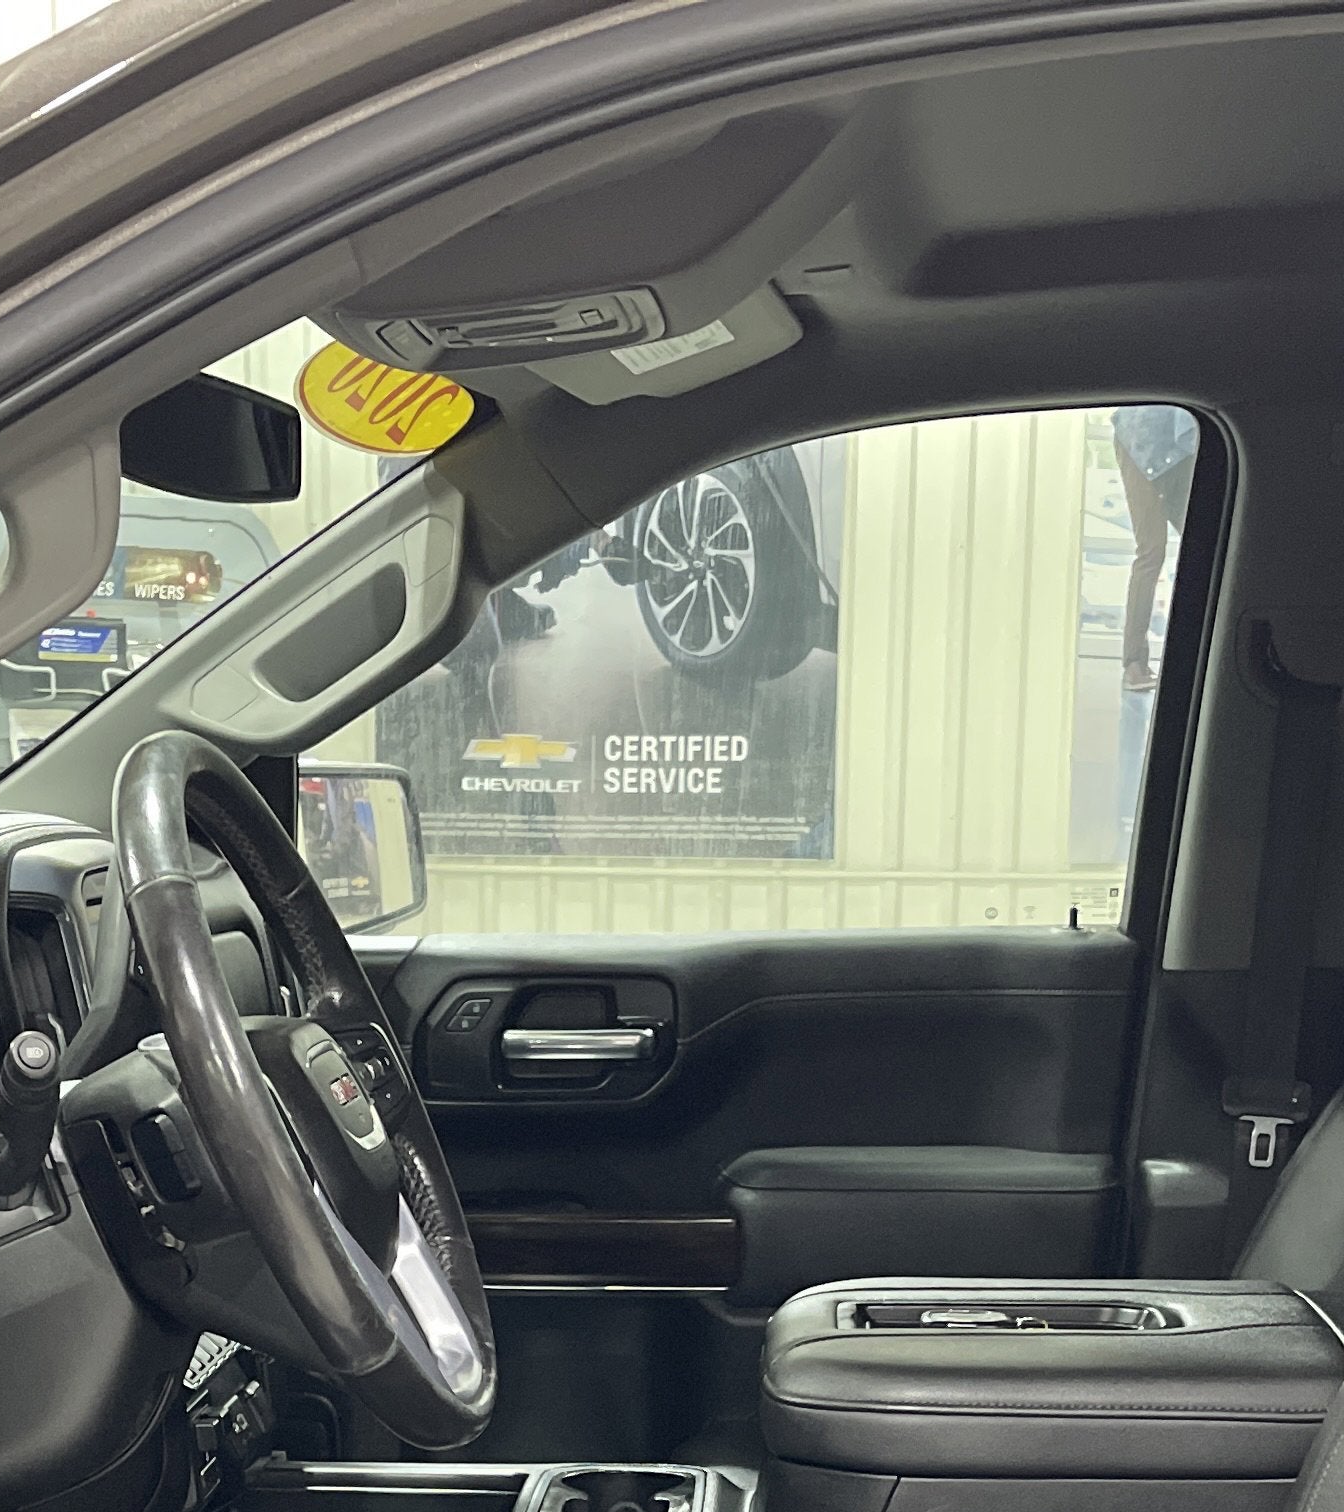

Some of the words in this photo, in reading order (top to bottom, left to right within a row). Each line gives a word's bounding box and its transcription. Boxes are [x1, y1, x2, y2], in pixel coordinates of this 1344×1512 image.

[93, 581, 115, 597] ES
[135, 583, 186, 600] WIPERS
[604, 735, 749, 762] CERTIFIED
[460, 776, 582, 793] CHEVROLET
[604, 767, 723, 794] SERVICE
